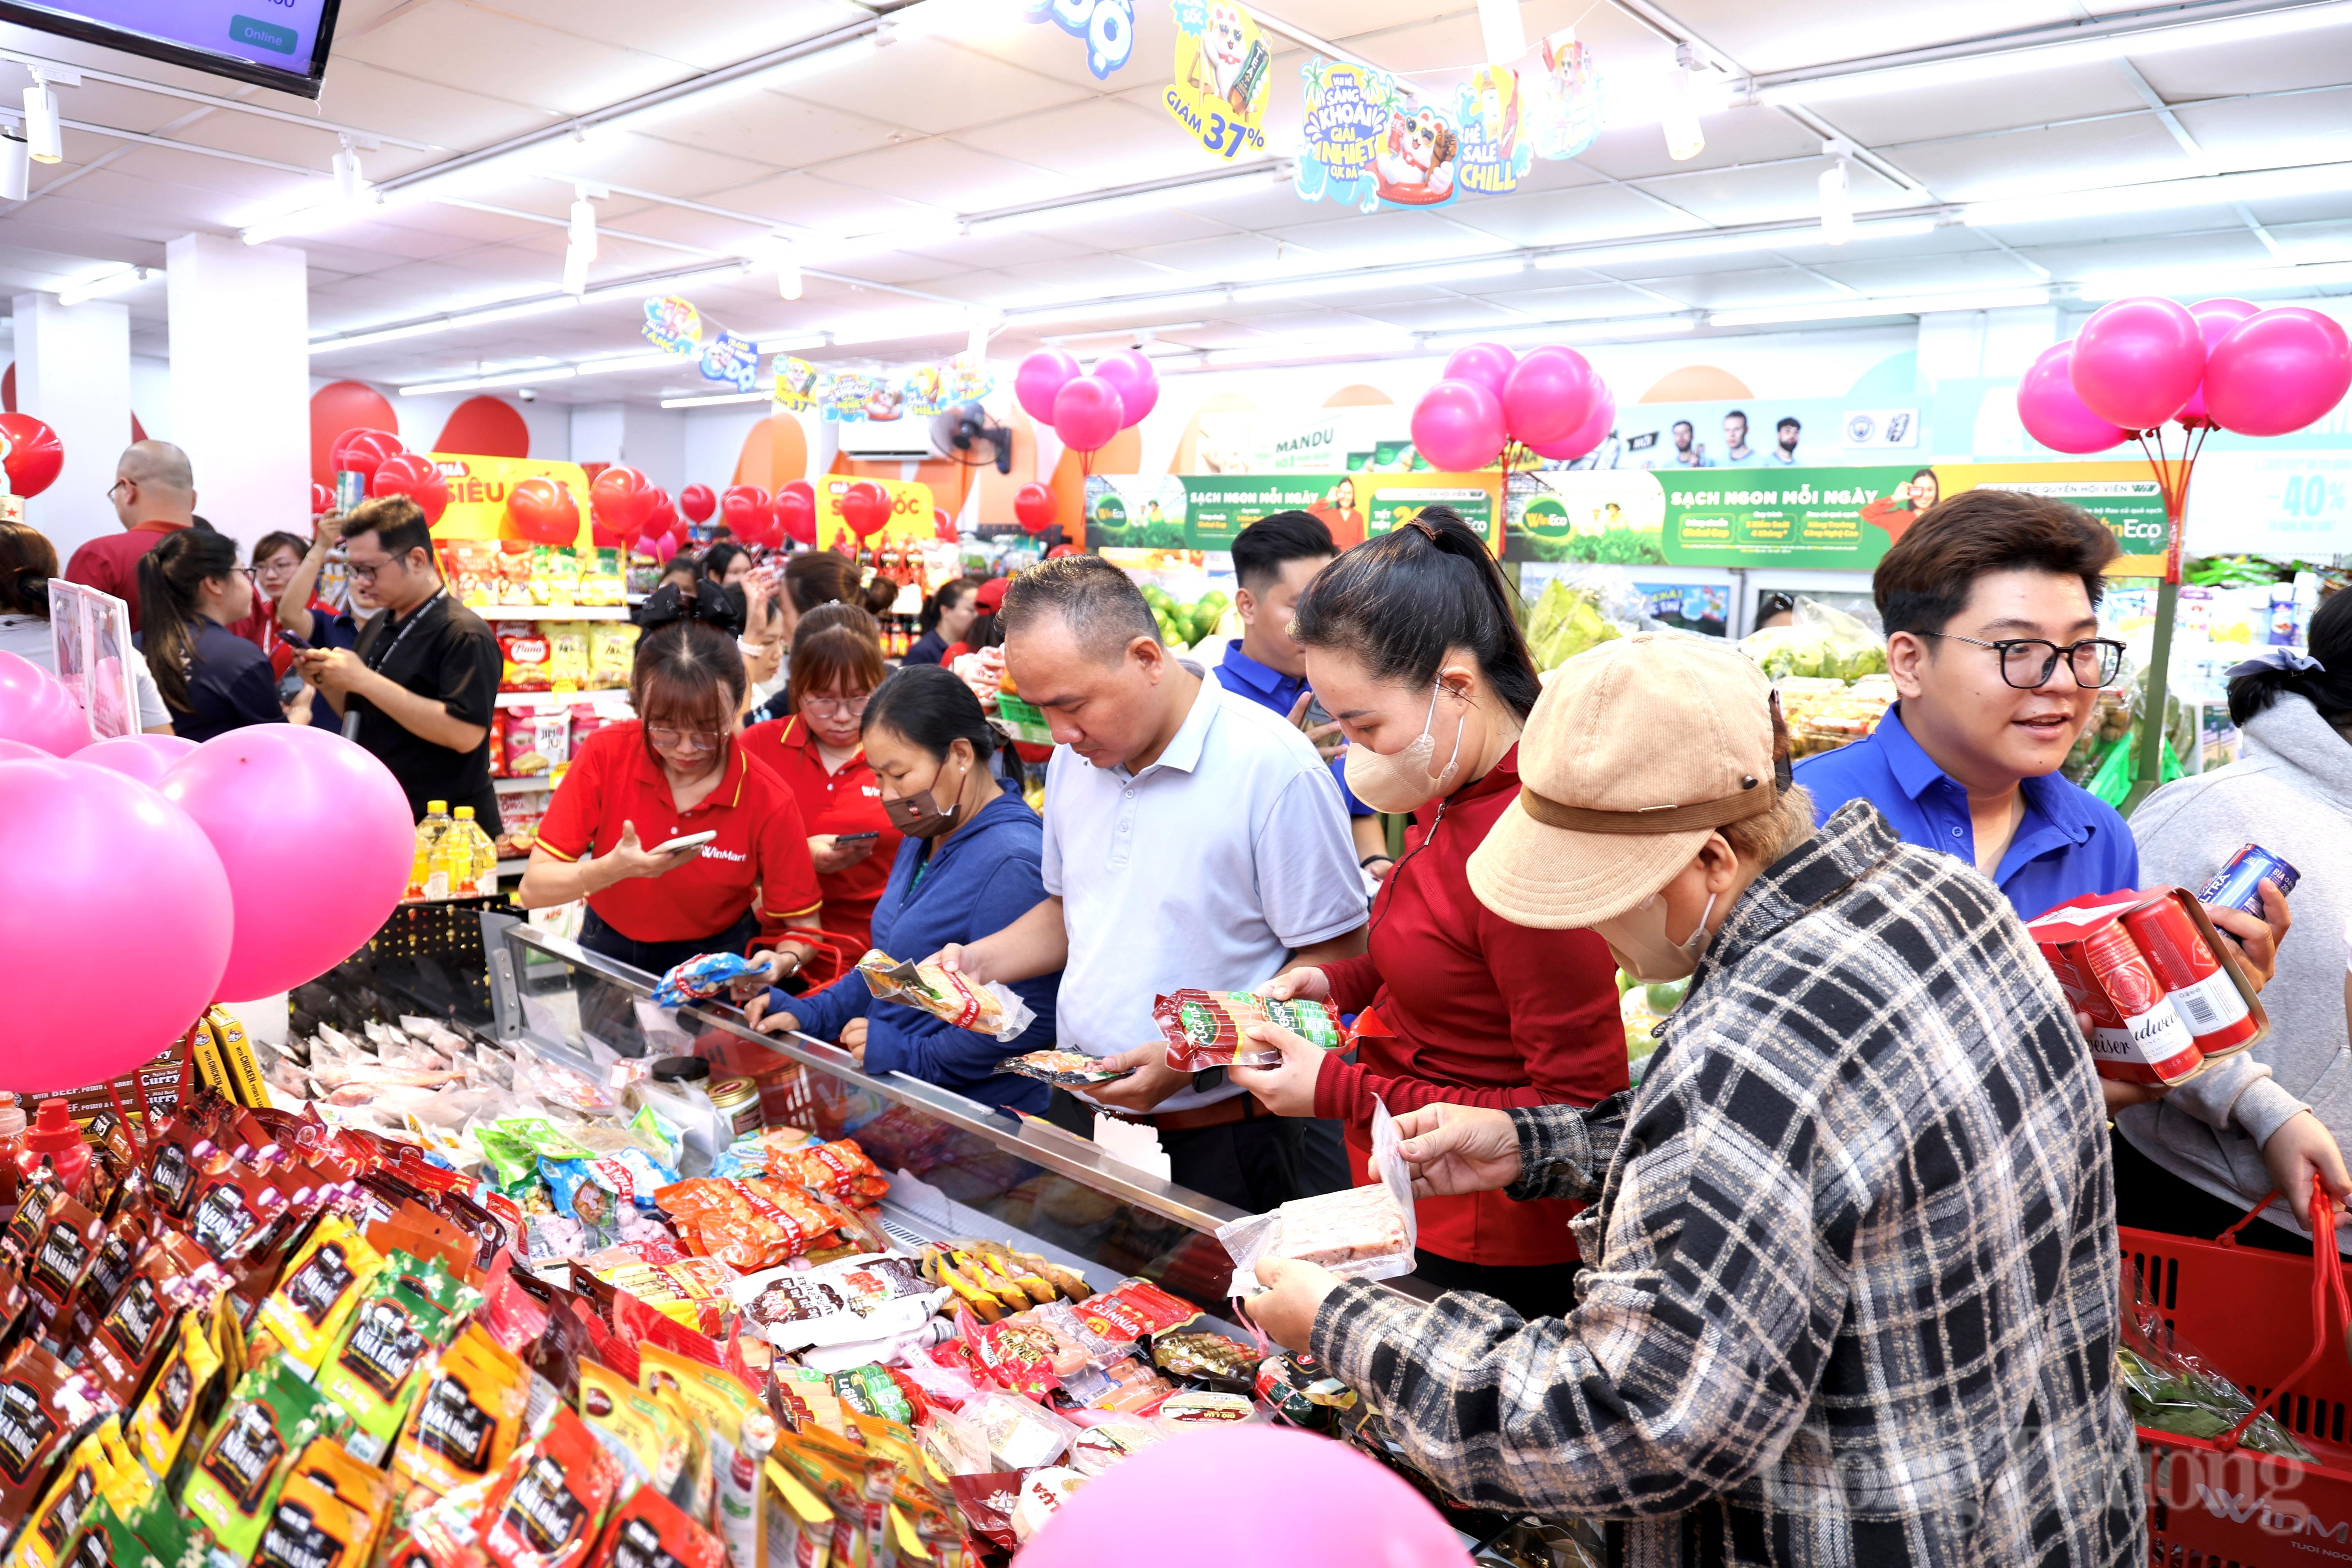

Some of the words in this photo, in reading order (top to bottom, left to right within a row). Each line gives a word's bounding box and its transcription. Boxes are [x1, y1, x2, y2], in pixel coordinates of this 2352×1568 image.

[243, 27, 283, 47] Online
[1333, 76, 1344, 86] VUI
[1326, 86, 1359, 106] SẢNG
[1167, 90, 1202, 134] GIẢM
[1203, 113, 1265, 158] 37%
[1319, 101, 1372, 131] KHOÁI
[1322, 136, 1375, 167] NHIỆT
[1463, 142, 1497, 163] SALE
[1460, 160, 1516, 191] CHILL
[907, 396, 929, 405] SALE
[1276, 428, 1333, 452] MANDU
[447, 476, 504, 503] SIÊU
[1671, 491, 1720, 509] SẠCH
[1724, 491, 1777, 505] NGON
[1782, 484, 1818, 505] MỖI
[1824, 486, 1878, 505] NGÀY
[2080, 484, 2100, 493] HỘI
[2103, 483, 2128, 492] VIÊN
[1190, 492, 1221, 506] SẠCH
[1223, 492, 1257, 504] NGON
[1097, 506, 1124, 521] WinEco
[1526, 512, 1567, 528] WinEco
[701, 844, 747, 862] WinMart
[2199, 873, 2231, 903] LTRA
[203, 1050, 212, 1061] WITH
[140, 1073, 181, 1087] Curry
[235, 1046, 244, 1057] WITH
[240, 1055, 257, 1085] CHICKEN,
[250, 1083, 259, 1098] POTATO
[114, 1080, 134, 1089] ARROT
[1093, 1301, 1141, 1335] WINNER
[1093, 1319, 1109, 1336] CP
[2195, 1483, 2349, 1544] WinM
[2323, 1548, 2352, 1562] NGO
